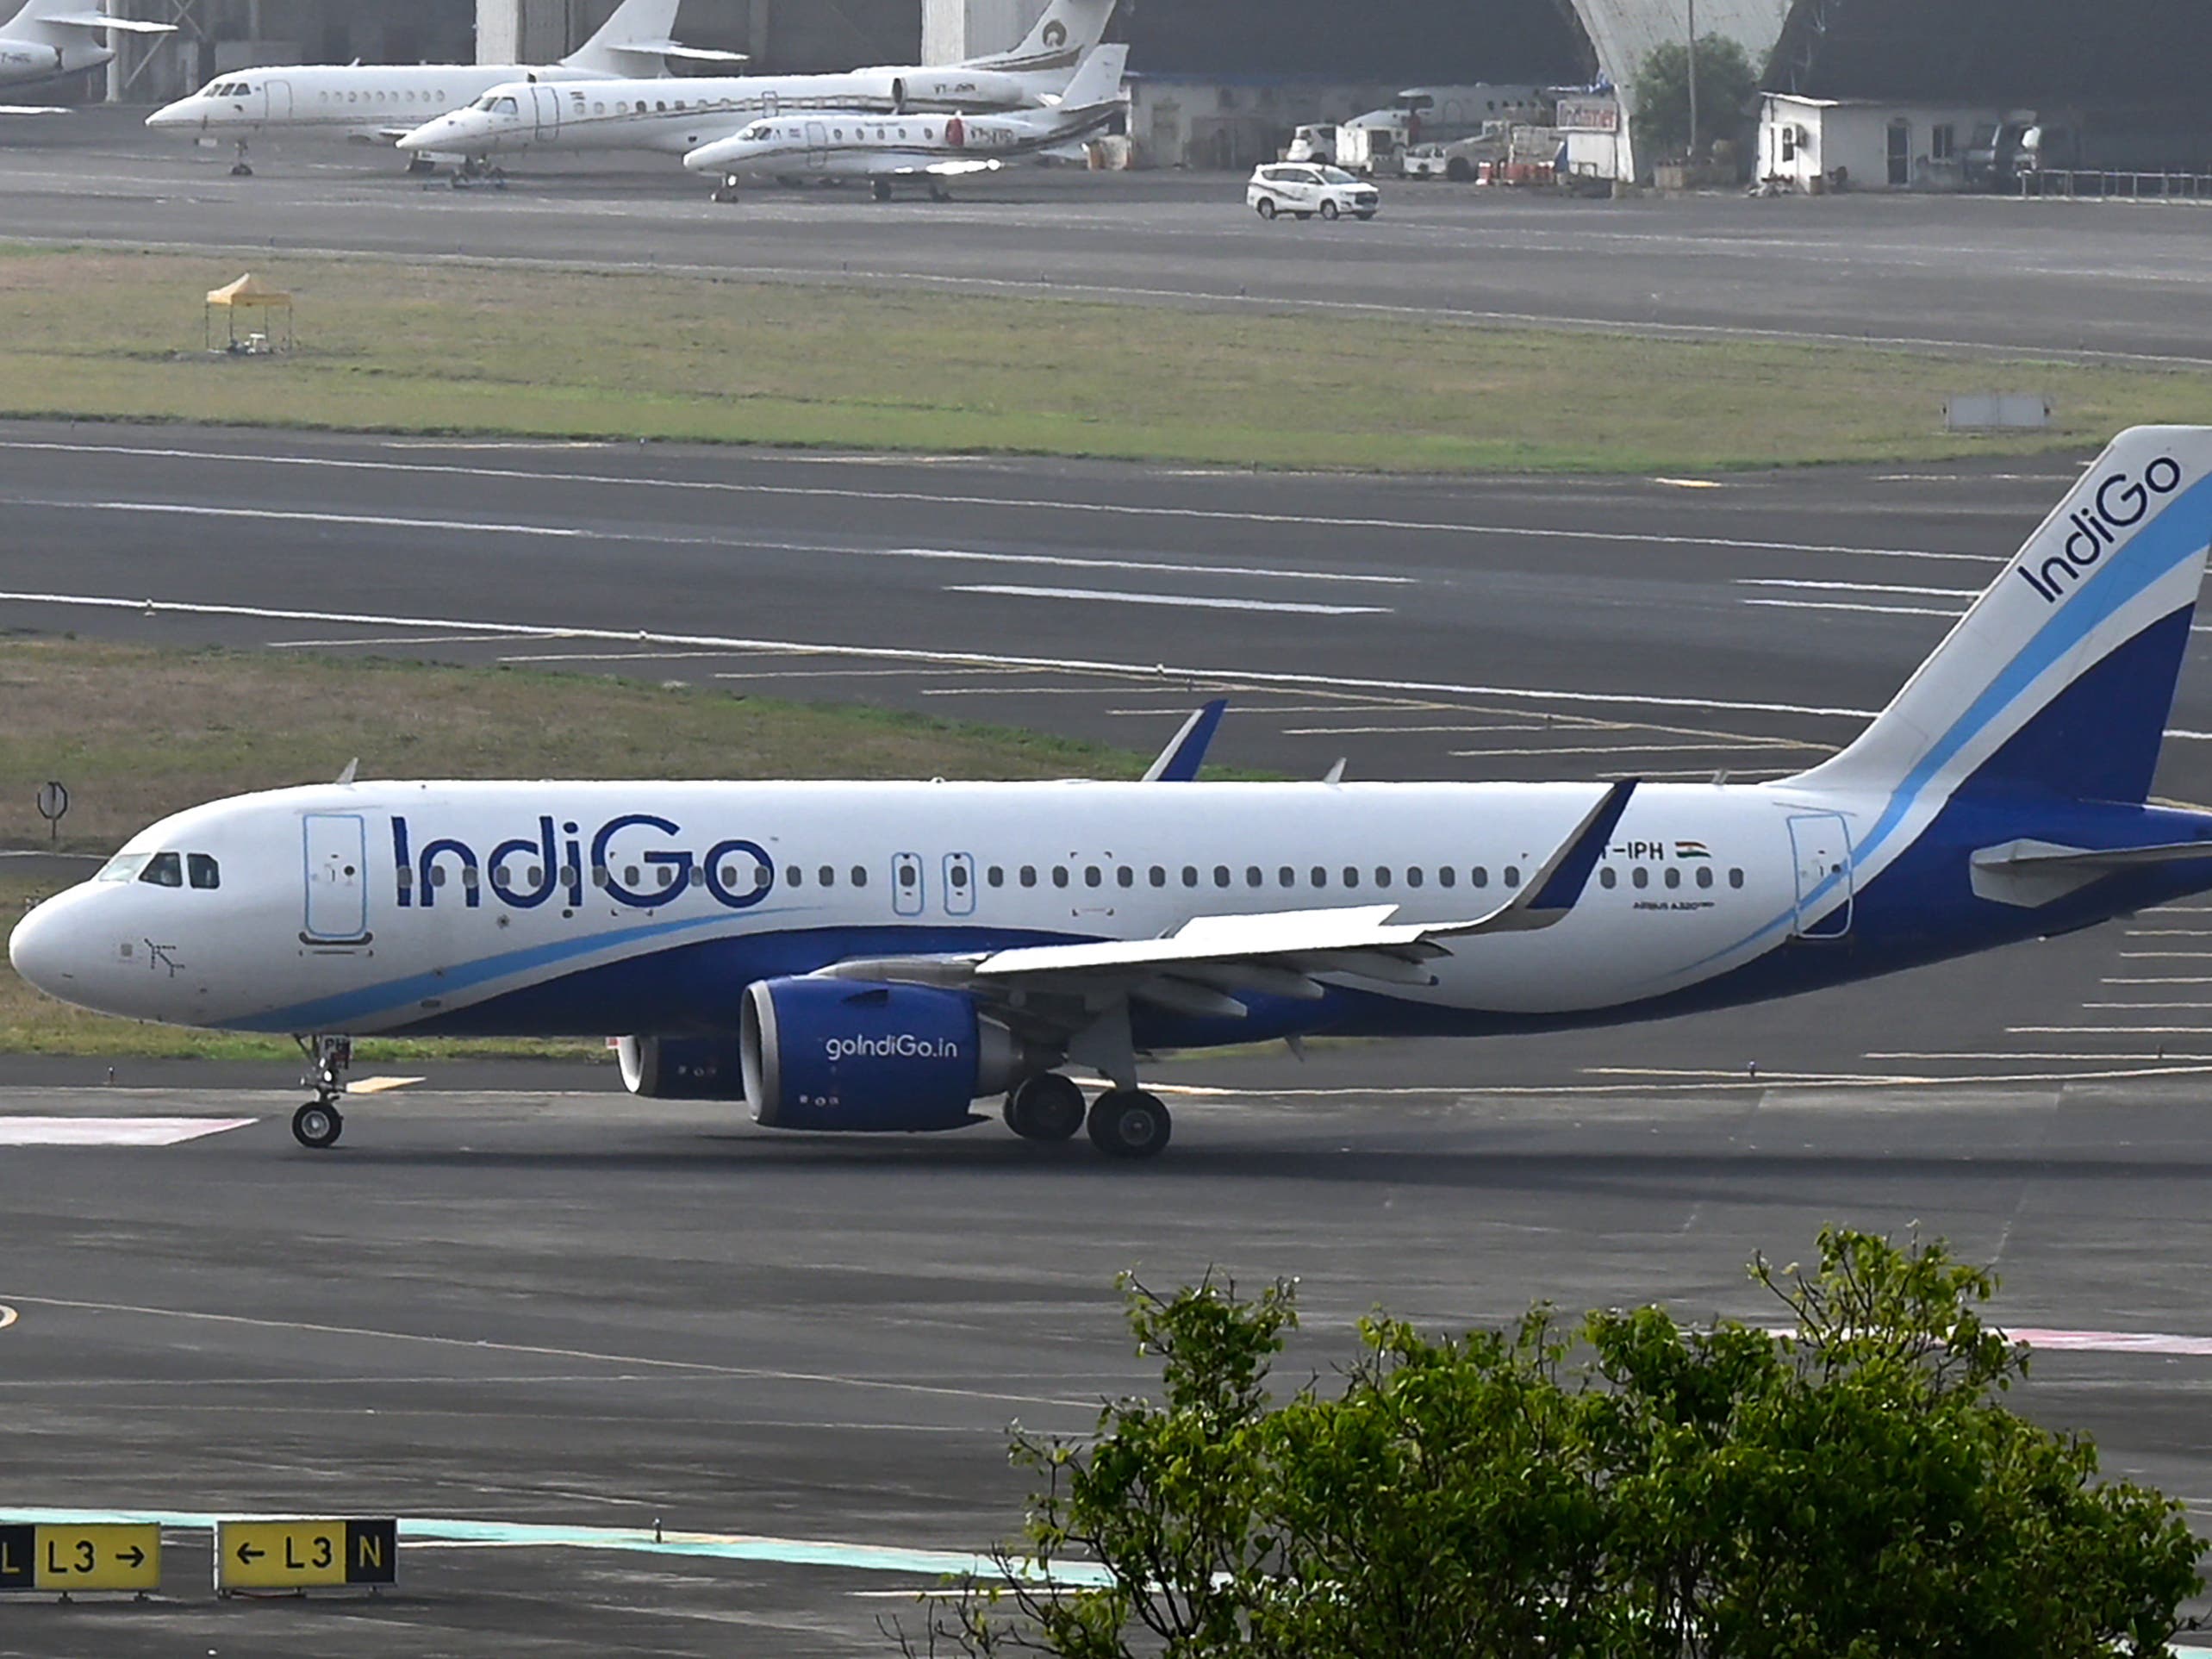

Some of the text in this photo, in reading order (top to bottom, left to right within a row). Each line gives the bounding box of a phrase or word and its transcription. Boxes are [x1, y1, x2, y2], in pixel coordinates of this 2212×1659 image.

[2017, 457, 2181, 603] IndiGo
[391, 814, 775, 908] IndiGo
[1600, 841, 1664, 860] T-IPH
[826, 1033, 957, 1061] goIndiGo.in
[2, 1540, 95, 1573] L L3
[285, 1535, 382, 1569] L3 N
